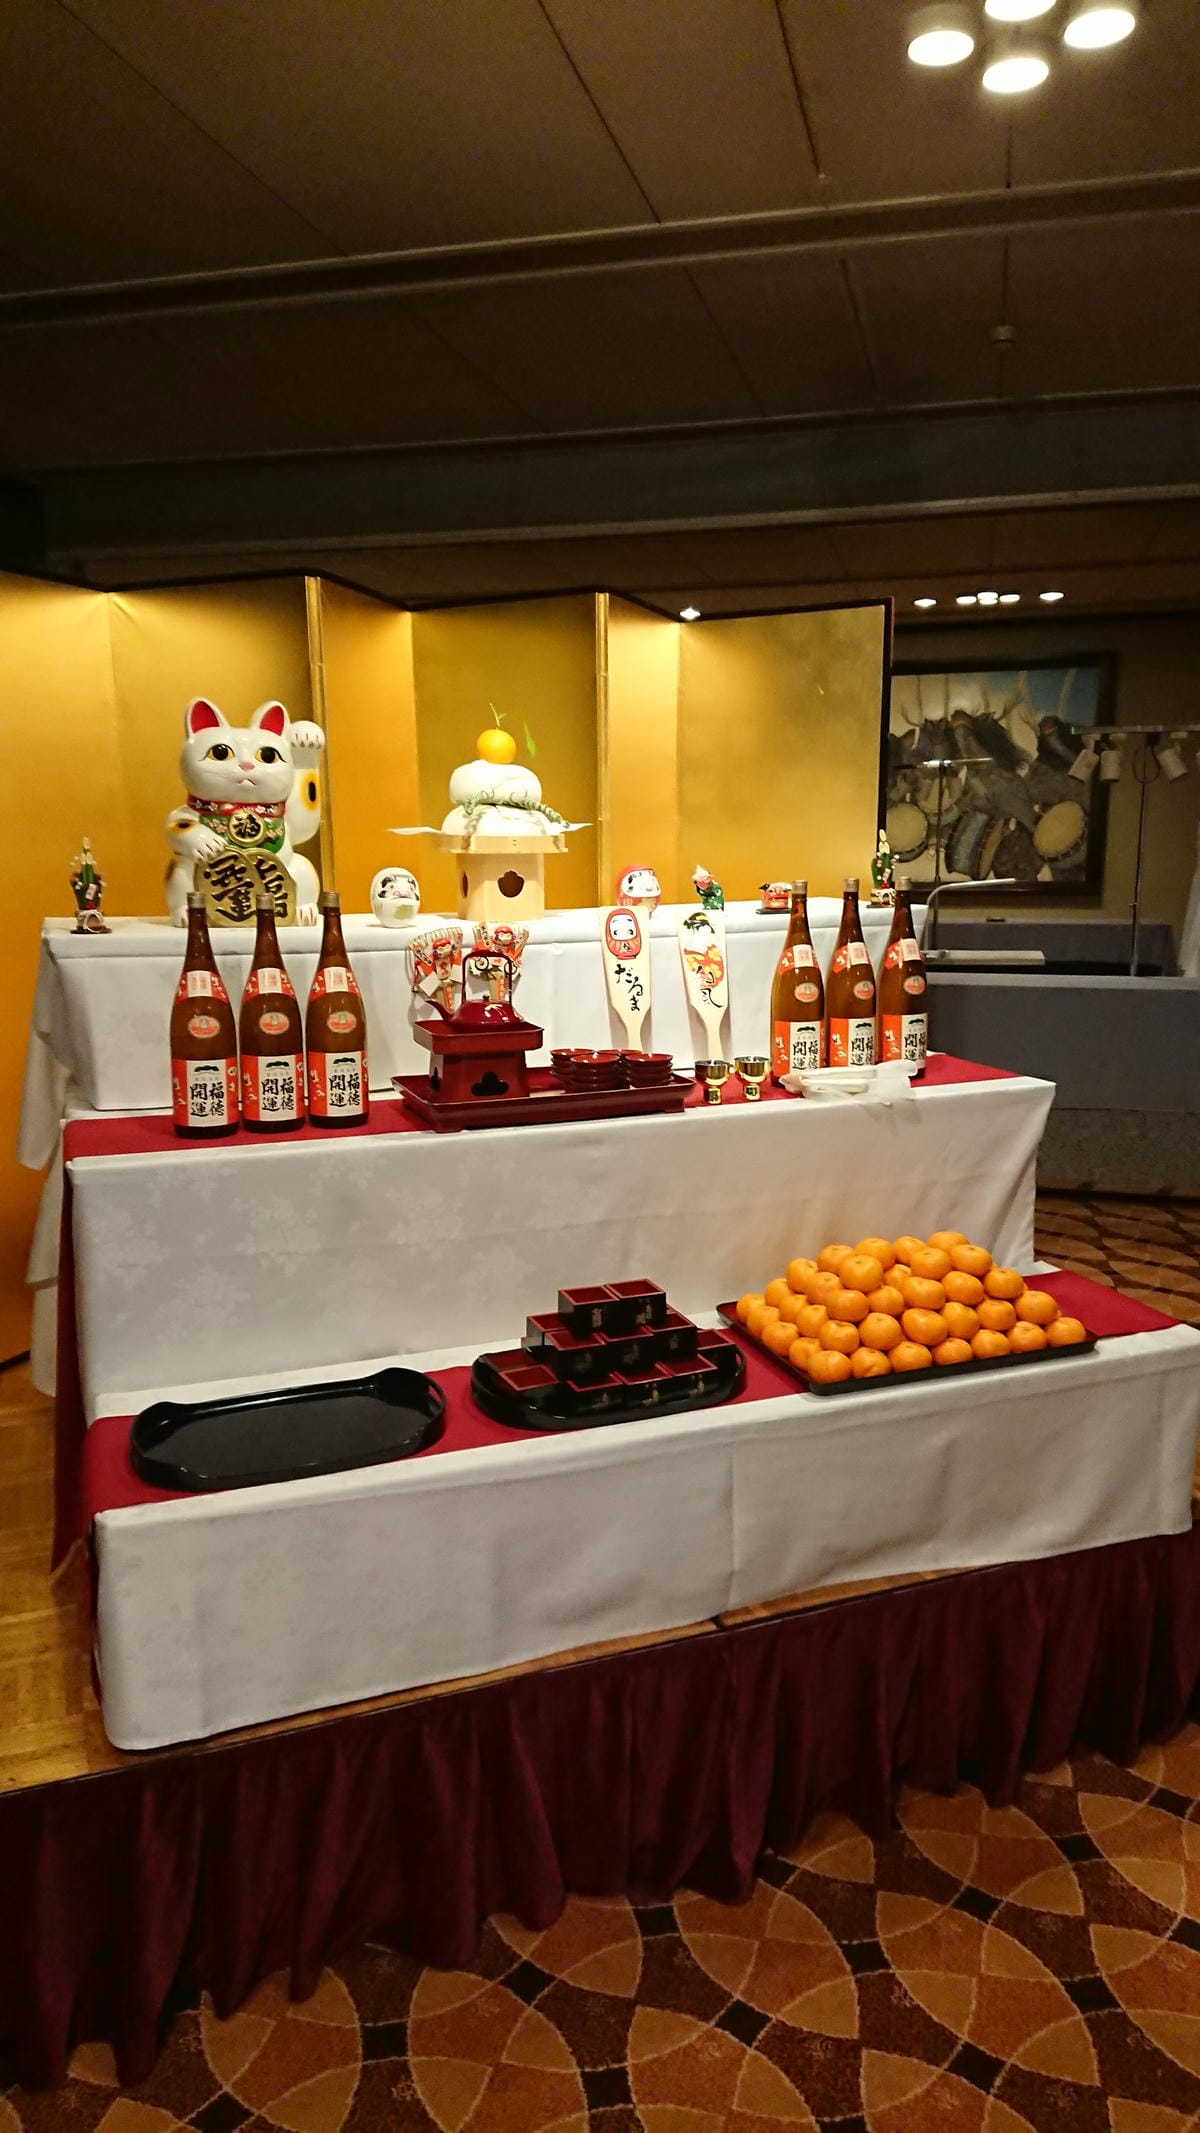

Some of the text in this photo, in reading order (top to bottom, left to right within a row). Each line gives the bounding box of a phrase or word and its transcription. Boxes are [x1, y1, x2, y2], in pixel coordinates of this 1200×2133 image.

[614, 963, 643, 1012] だるま
[189, 1083, 209, 1117] 開運
[261, 1078, 281, 1112] 開運
[328, 1074, 348, 1107] 開運
